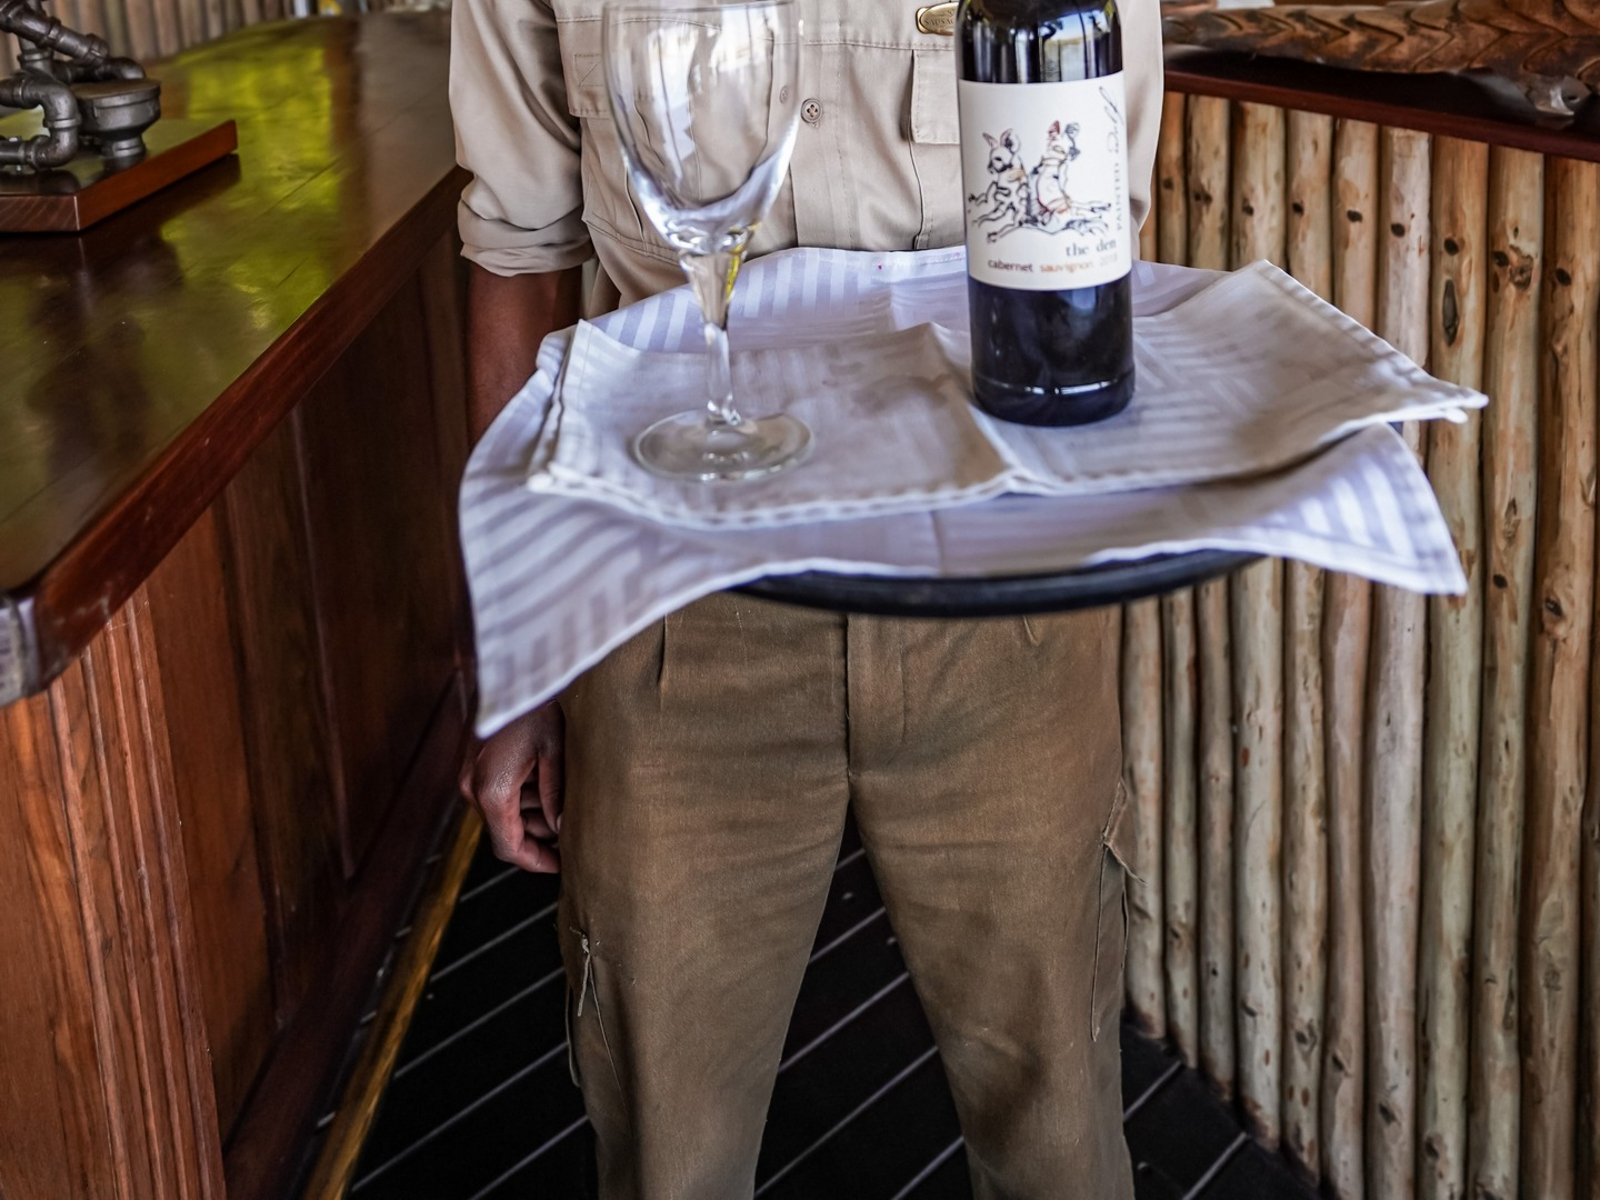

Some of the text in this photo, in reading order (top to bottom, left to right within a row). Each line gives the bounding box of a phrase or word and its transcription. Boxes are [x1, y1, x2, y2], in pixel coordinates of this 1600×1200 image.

[1066, 237, 1117, 258] the den
[987, 258, 1034, 273] cabernet
[1040, 259, 1094, 274] sauvignon
